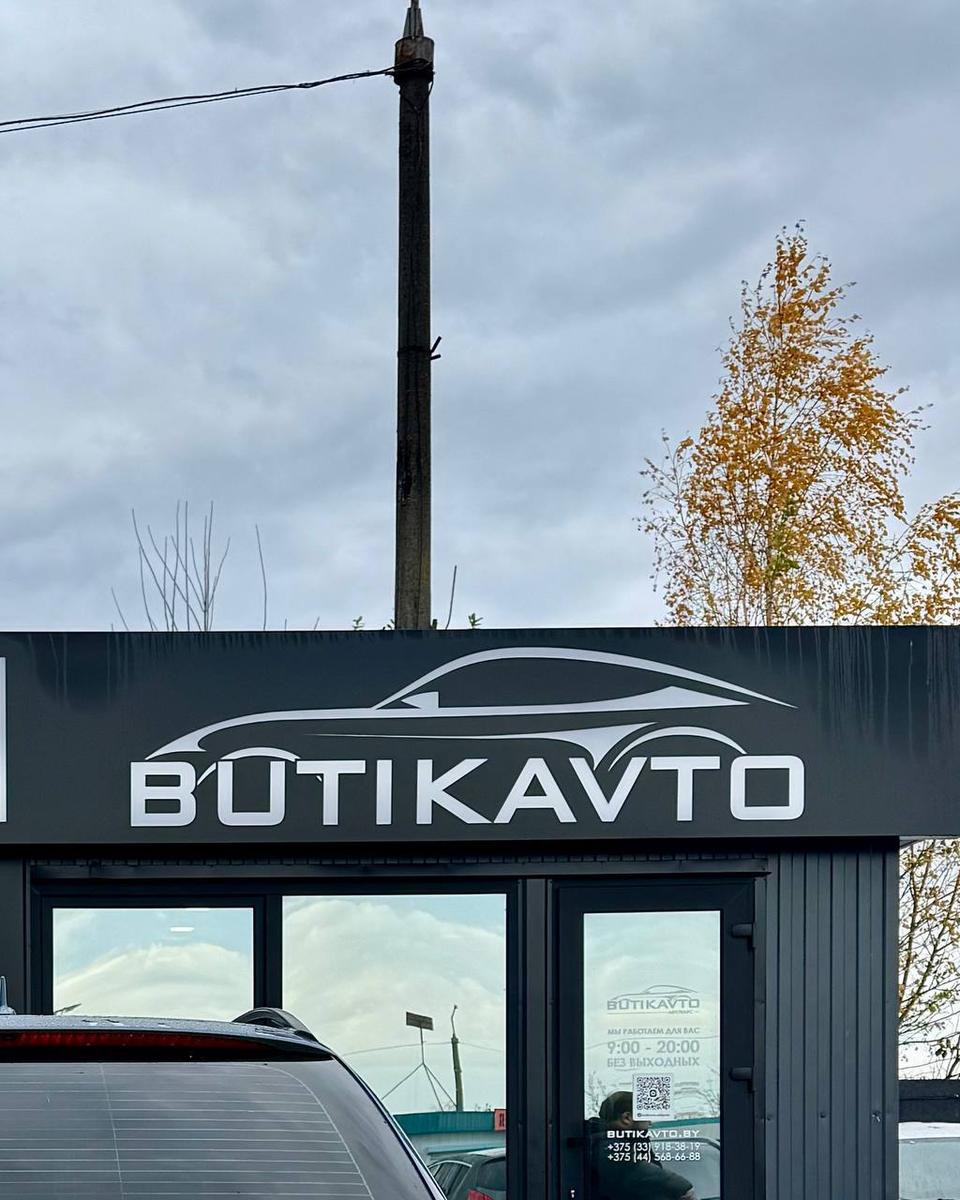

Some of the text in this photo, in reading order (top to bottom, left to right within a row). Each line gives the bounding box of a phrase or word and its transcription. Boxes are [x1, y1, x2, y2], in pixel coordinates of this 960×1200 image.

[130, 754, 806, 827] BUTIKAVTO
[607, 998, 700, 1010] BUTIKAVTO
[607, 1041, 640, 1054] 9:00
[656, 1040, 700, 1053] 20:00
[607, 1056, 700, 1067] БЕЗ ВЫХОДНЫХ
[607, 1130, 700, 1138] BUTIKAVTO.BY
[607, 1143, 631, 1151] +375
[633, 1142, 651, 1153] (33)
[607, 1152, 701, 1163] +375 (44) 568-66-88
